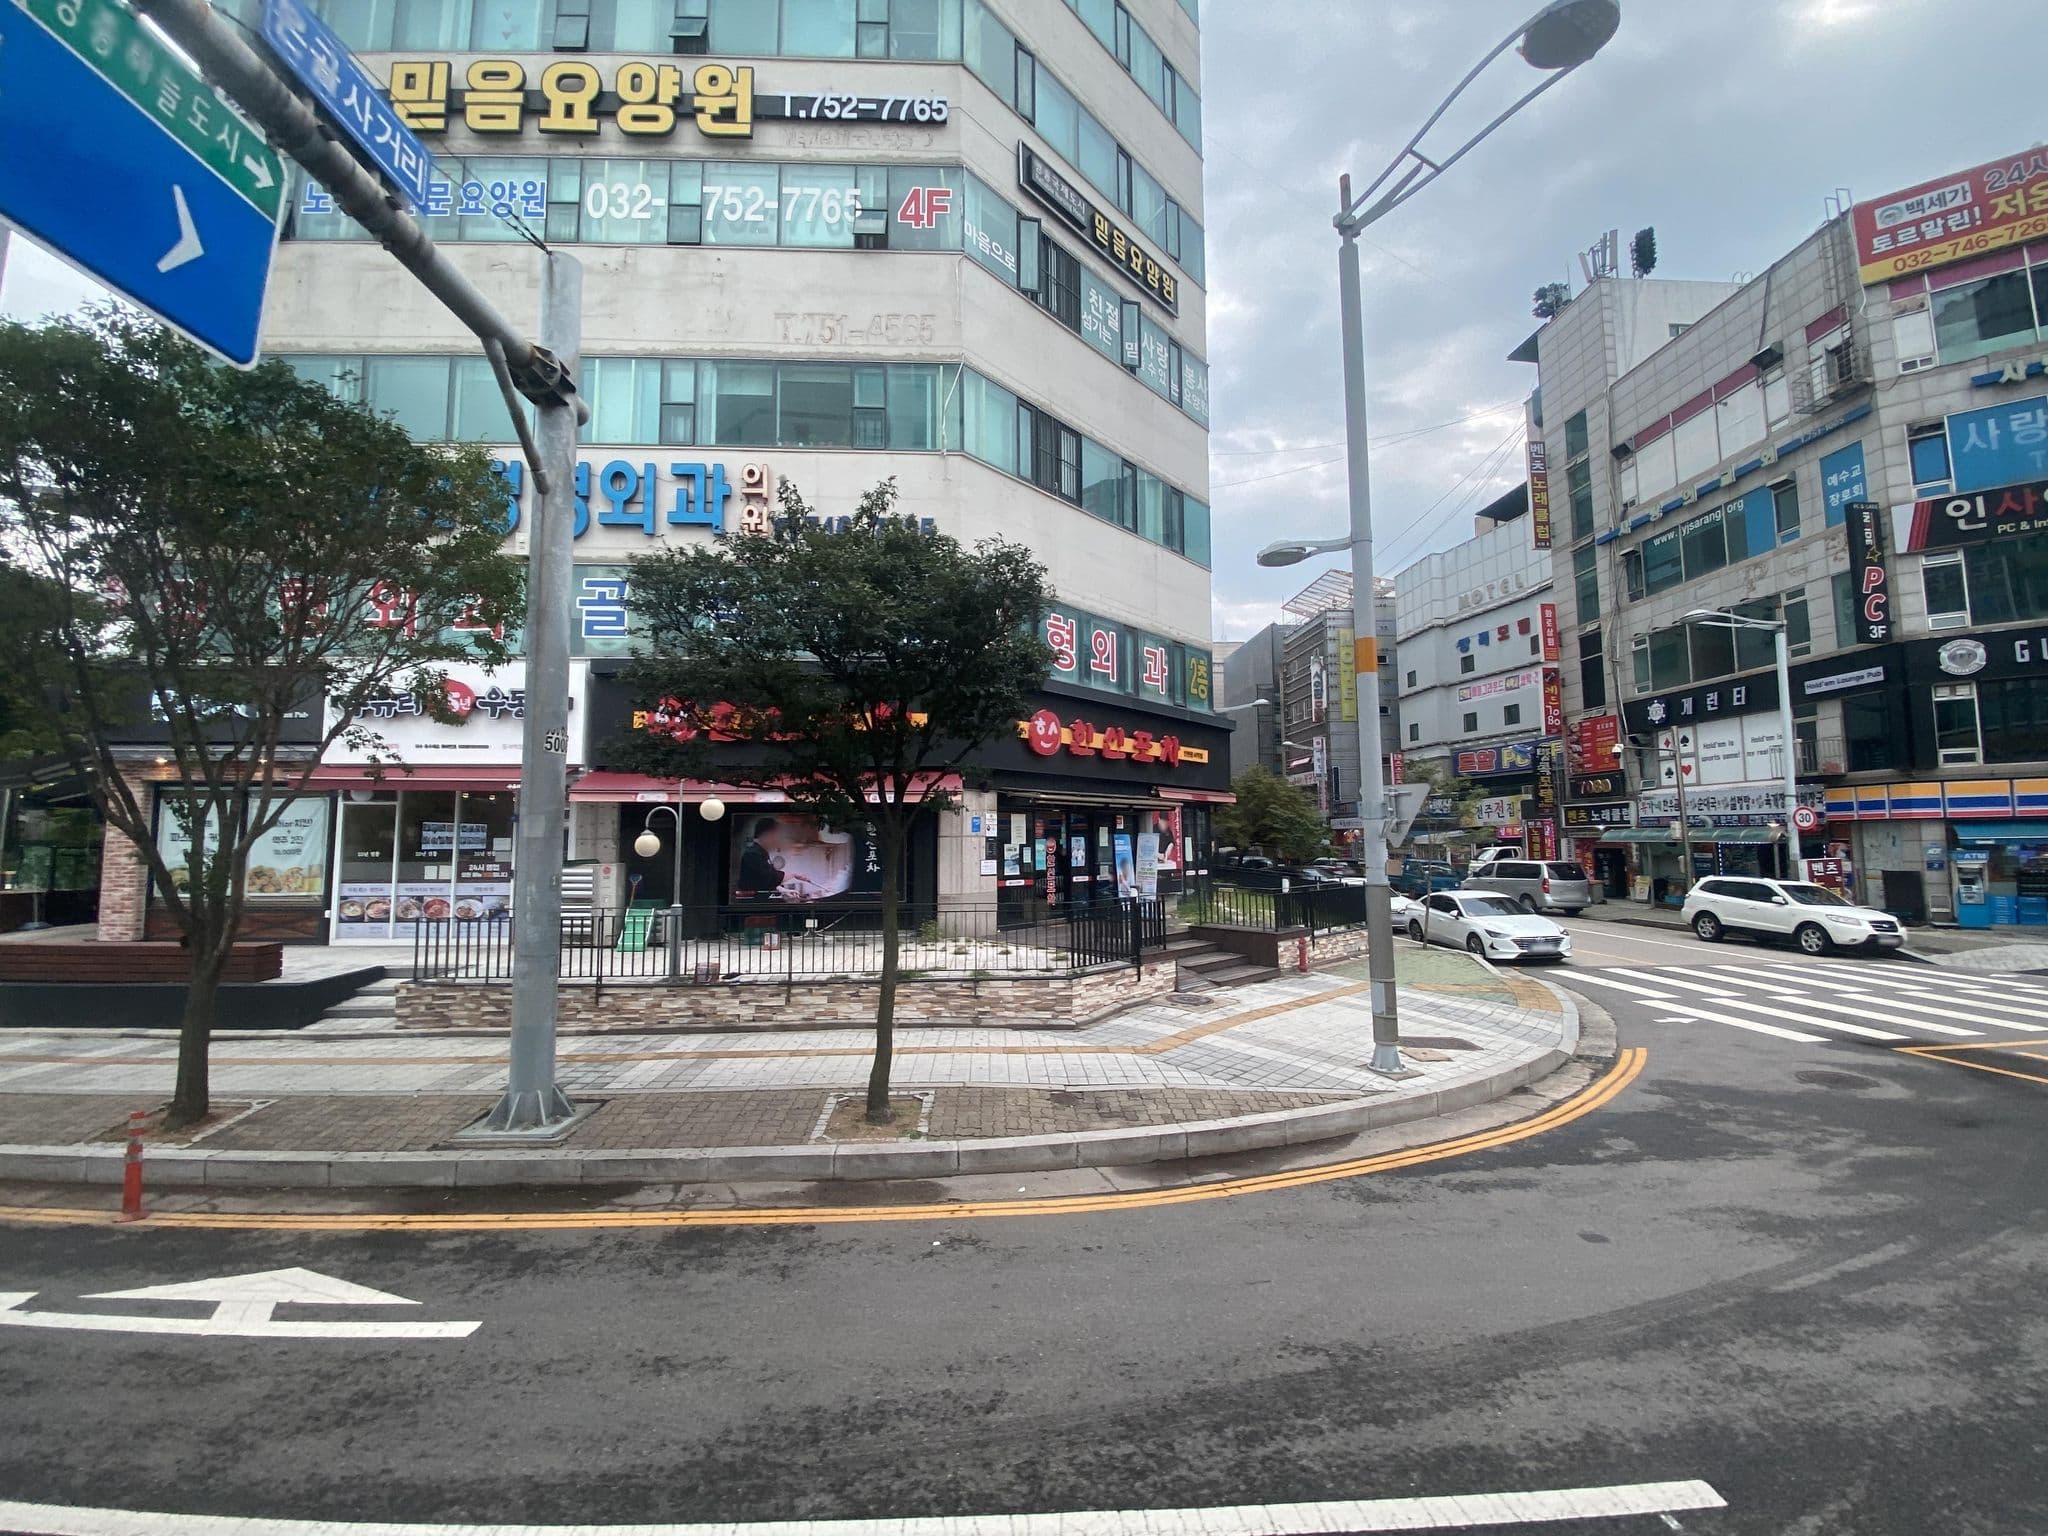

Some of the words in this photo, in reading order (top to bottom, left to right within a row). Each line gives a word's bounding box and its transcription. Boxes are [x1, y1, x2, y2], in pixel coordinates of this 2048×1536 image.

[390, 60, 754, 139] 믿음요양원
[782, 92, 948, 122] T.752-7765
[897, 186, 950, 229] 4F
[1905, 184, 1970, 215] 백세가
[964, 220, 1017, 273] 마음으로
[1093, 210, 1174, 304] 믿음요양원
[1893, 217, 2048, 273] 032-746-726
[1827, 464, 1862, 487] 예수교
[1945, 486, 2048, 531] 인사
[1869, 625, 1887, 638] 3F
[1798, 812, 1812, 823] 30
